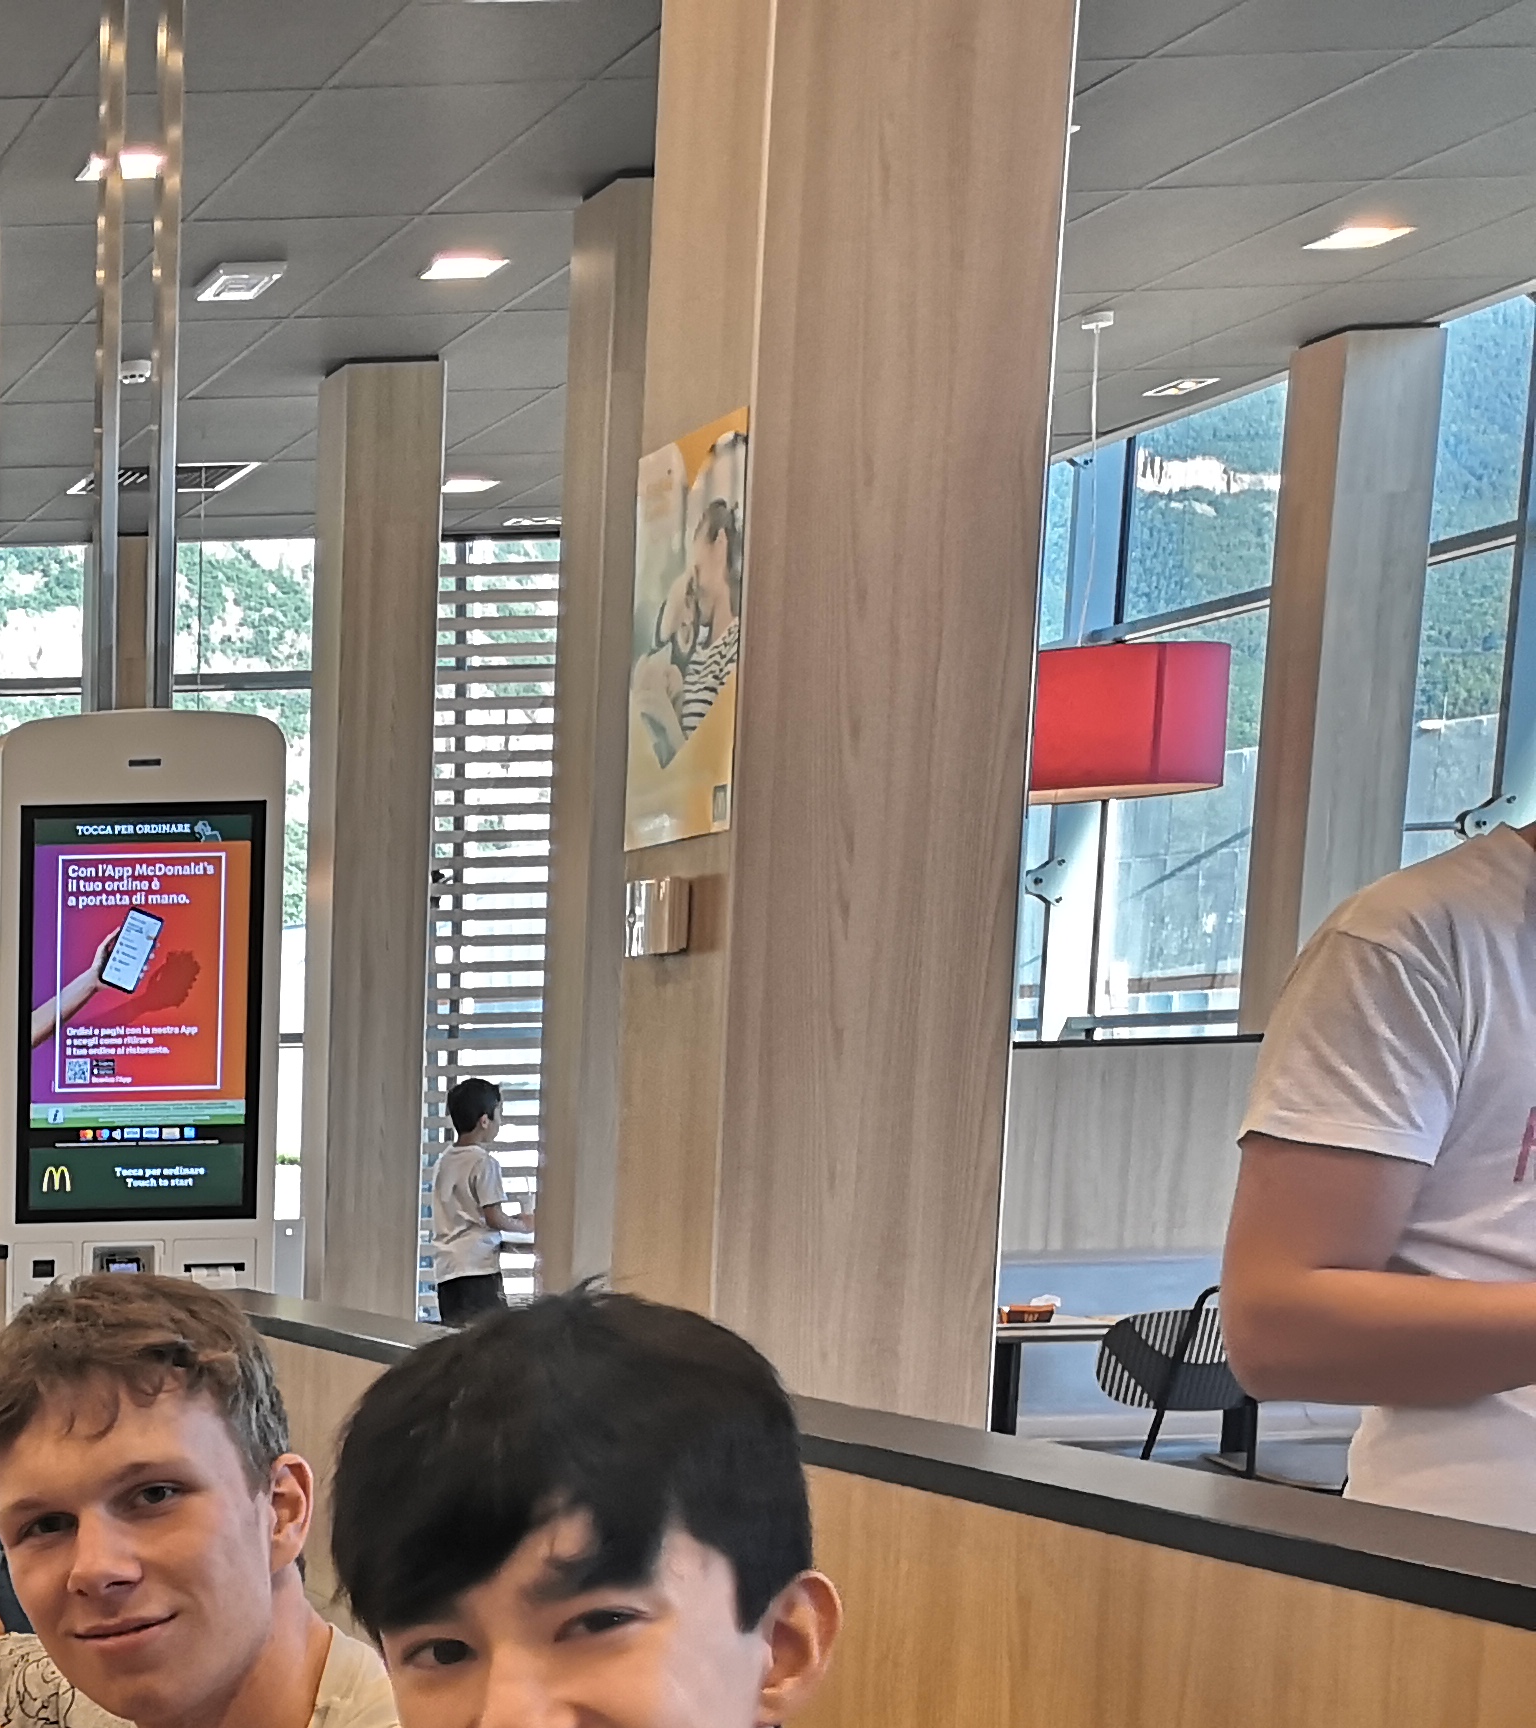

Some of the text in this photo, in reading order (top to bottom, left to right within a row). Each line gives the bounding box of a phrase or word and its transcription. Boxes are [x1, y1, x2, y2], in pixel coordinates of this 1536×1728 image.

[76, 823, 191, 836] TOCCA PER ORDINARE
[68, 862, 214, 879] Con l'App McDonald's
[68, 879, 77, 892] il
[79, 879, 103, 892] tuo
[105, 878, 149, 891] ordine
[67, 891, 190, 909] a portata di mano.
[180, 1025, 198, 1035] App
[114, 1165, 205, 1177] Tocca per ordinare
[125, 1177, 194, 1188] Touch to start
